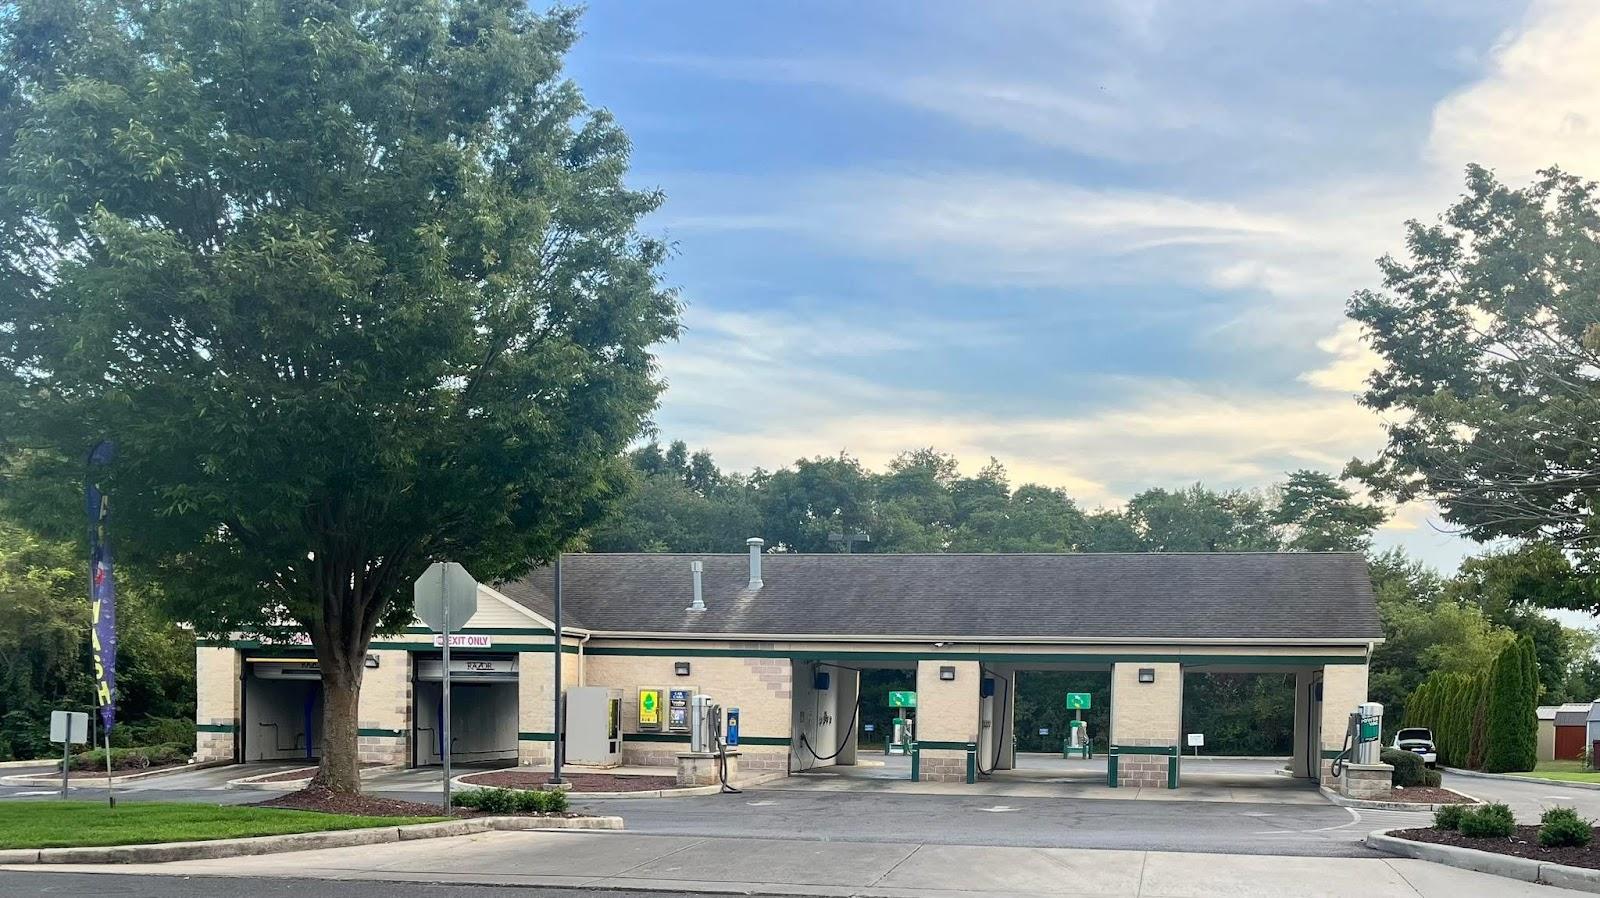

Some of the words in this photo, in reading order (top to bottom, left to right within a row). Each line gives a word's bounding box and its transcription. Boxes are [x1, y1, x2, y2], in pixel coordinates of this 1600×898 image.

[449, 636, 466, 645] EXIT
[468, 636, 488, 645] ONLY
[467, 661, 493, 671] RAZOR
